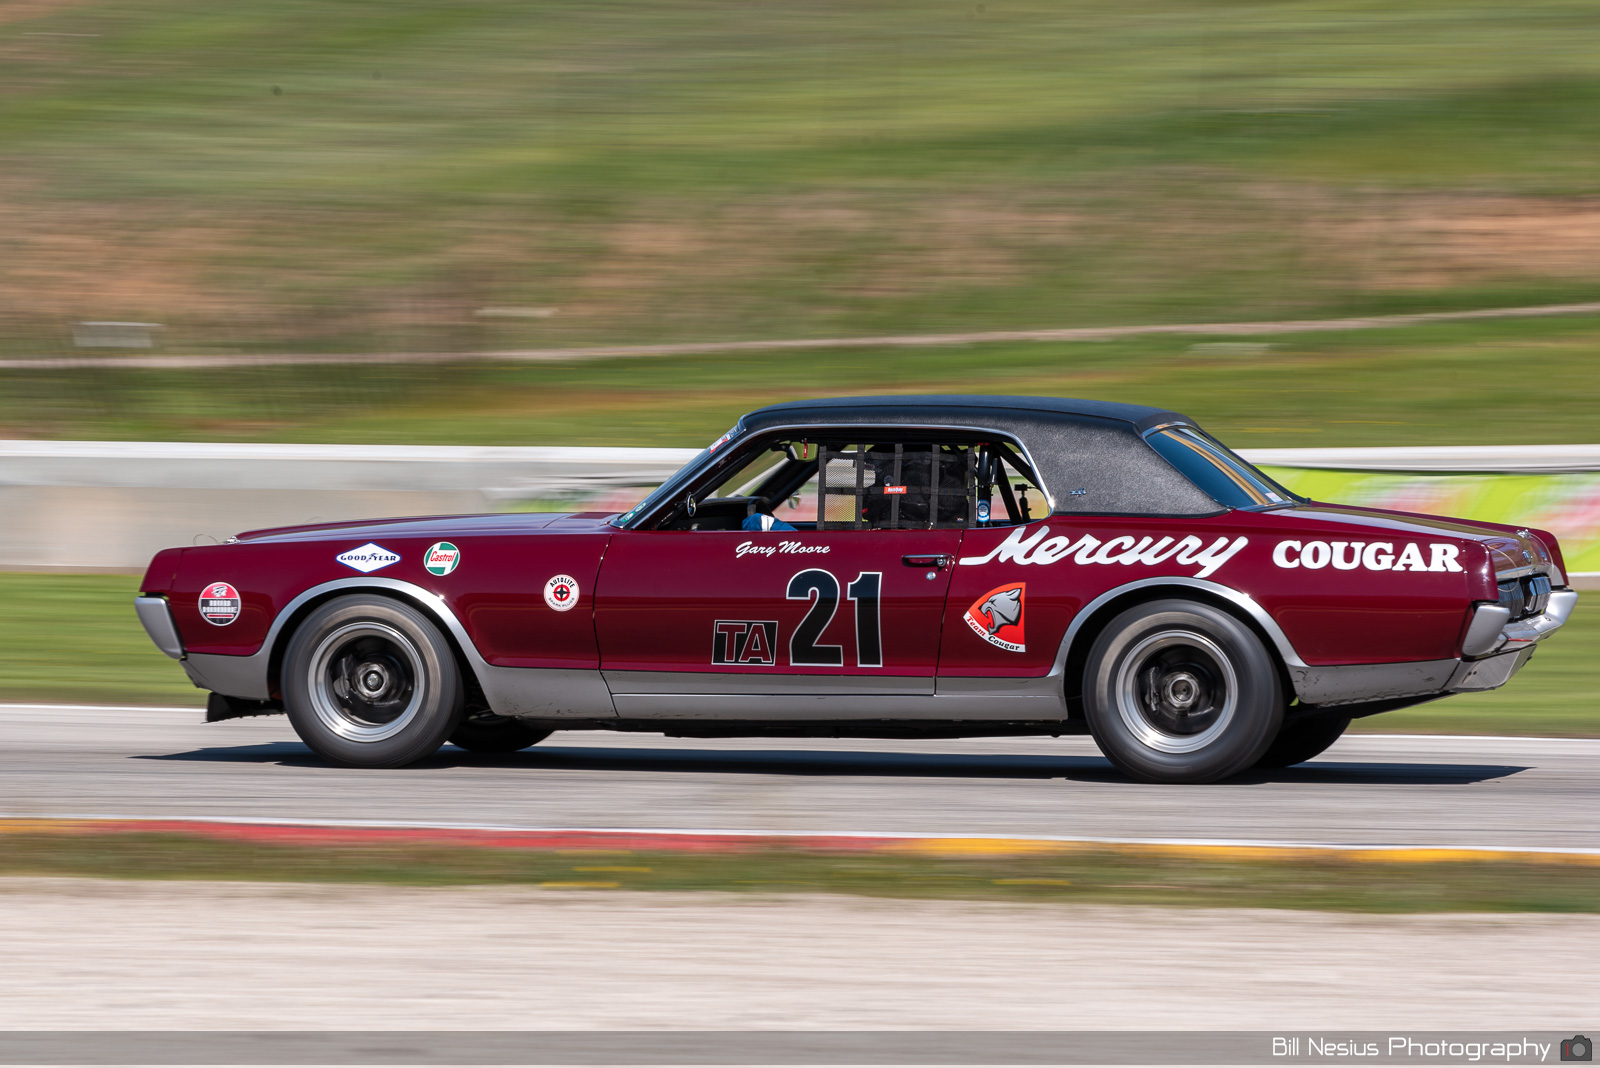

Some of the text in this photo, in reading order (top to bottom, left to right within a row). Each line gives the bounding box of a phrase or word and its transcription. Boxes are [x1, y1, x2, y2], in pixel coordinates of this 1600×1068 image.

[430, 550, 457, 562] Castrol
[735, 540, 831, 558] Gary Moore
[959, 525, 1249, 578] Mercury
[1272, 540, 1463, 572] COUGAR
[550, 577, 575, 588] AUTOLITE
[786, 568, 883, 667] 21
[966, 615, 1020, 650] Team Cougar
[717, 622, 773, 663] TA
